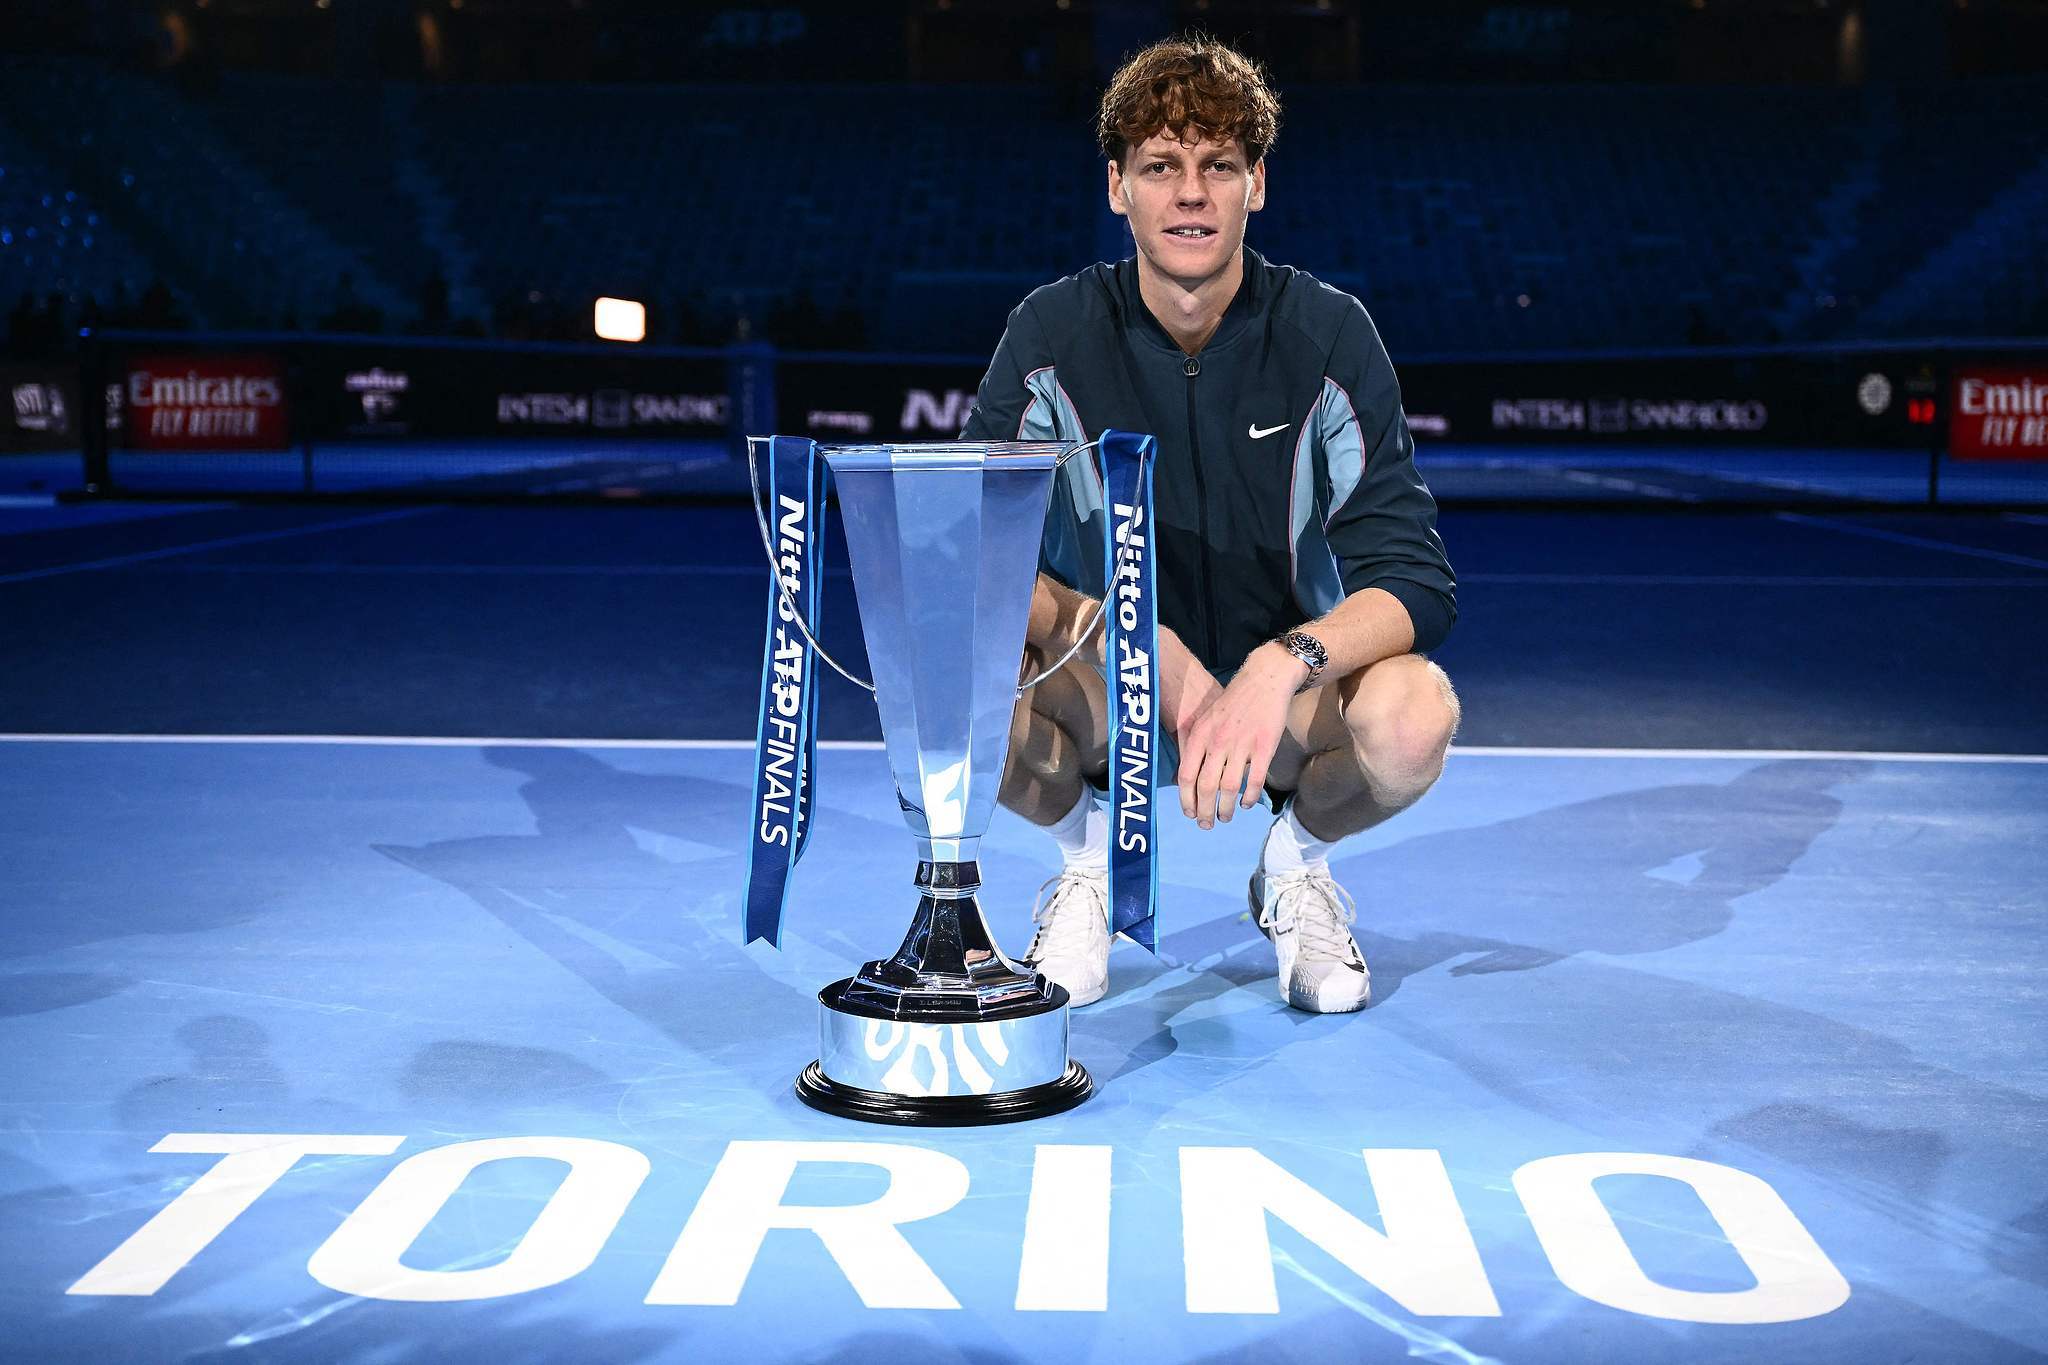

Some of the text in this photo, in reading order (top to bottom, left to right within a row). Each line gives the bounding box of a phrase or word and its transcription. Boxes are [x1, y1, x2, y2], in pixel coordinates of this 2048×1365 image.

[759, 493, 806, 847] Nitto ATP FINALS
[1113, 502, 1152, 854] Nitto ATP FINALS
[65, 1132, 1852, 1325] TORINO
